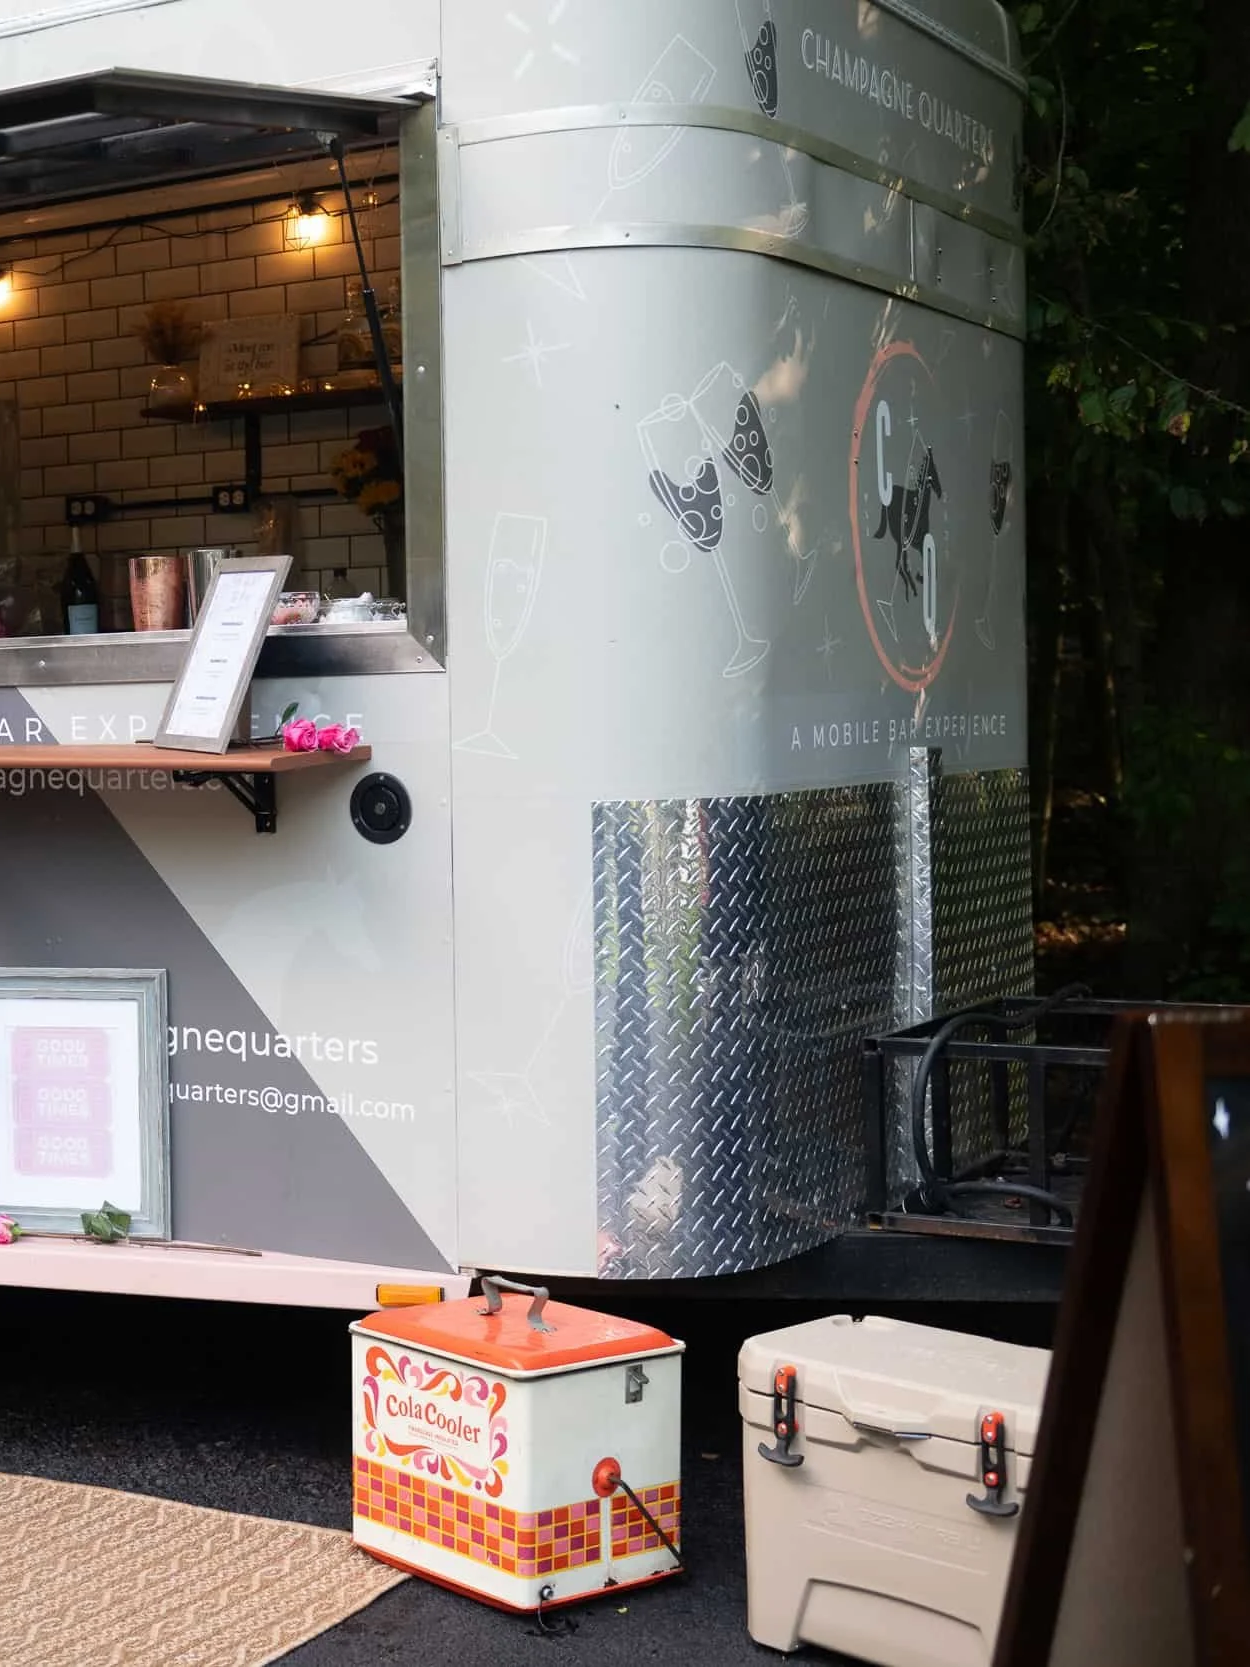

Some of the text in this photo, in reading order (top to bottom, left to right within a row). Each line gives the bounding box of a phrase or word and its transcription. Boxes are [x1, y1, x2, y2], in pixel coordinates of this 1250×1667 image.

[801, 28, 914, 120] CHAMPAGNE
[791, 714, 1006, 750] A MOBILE BAR EXPERIENCE
[169, 1082, 416, 1123] uarters@gmail.com
